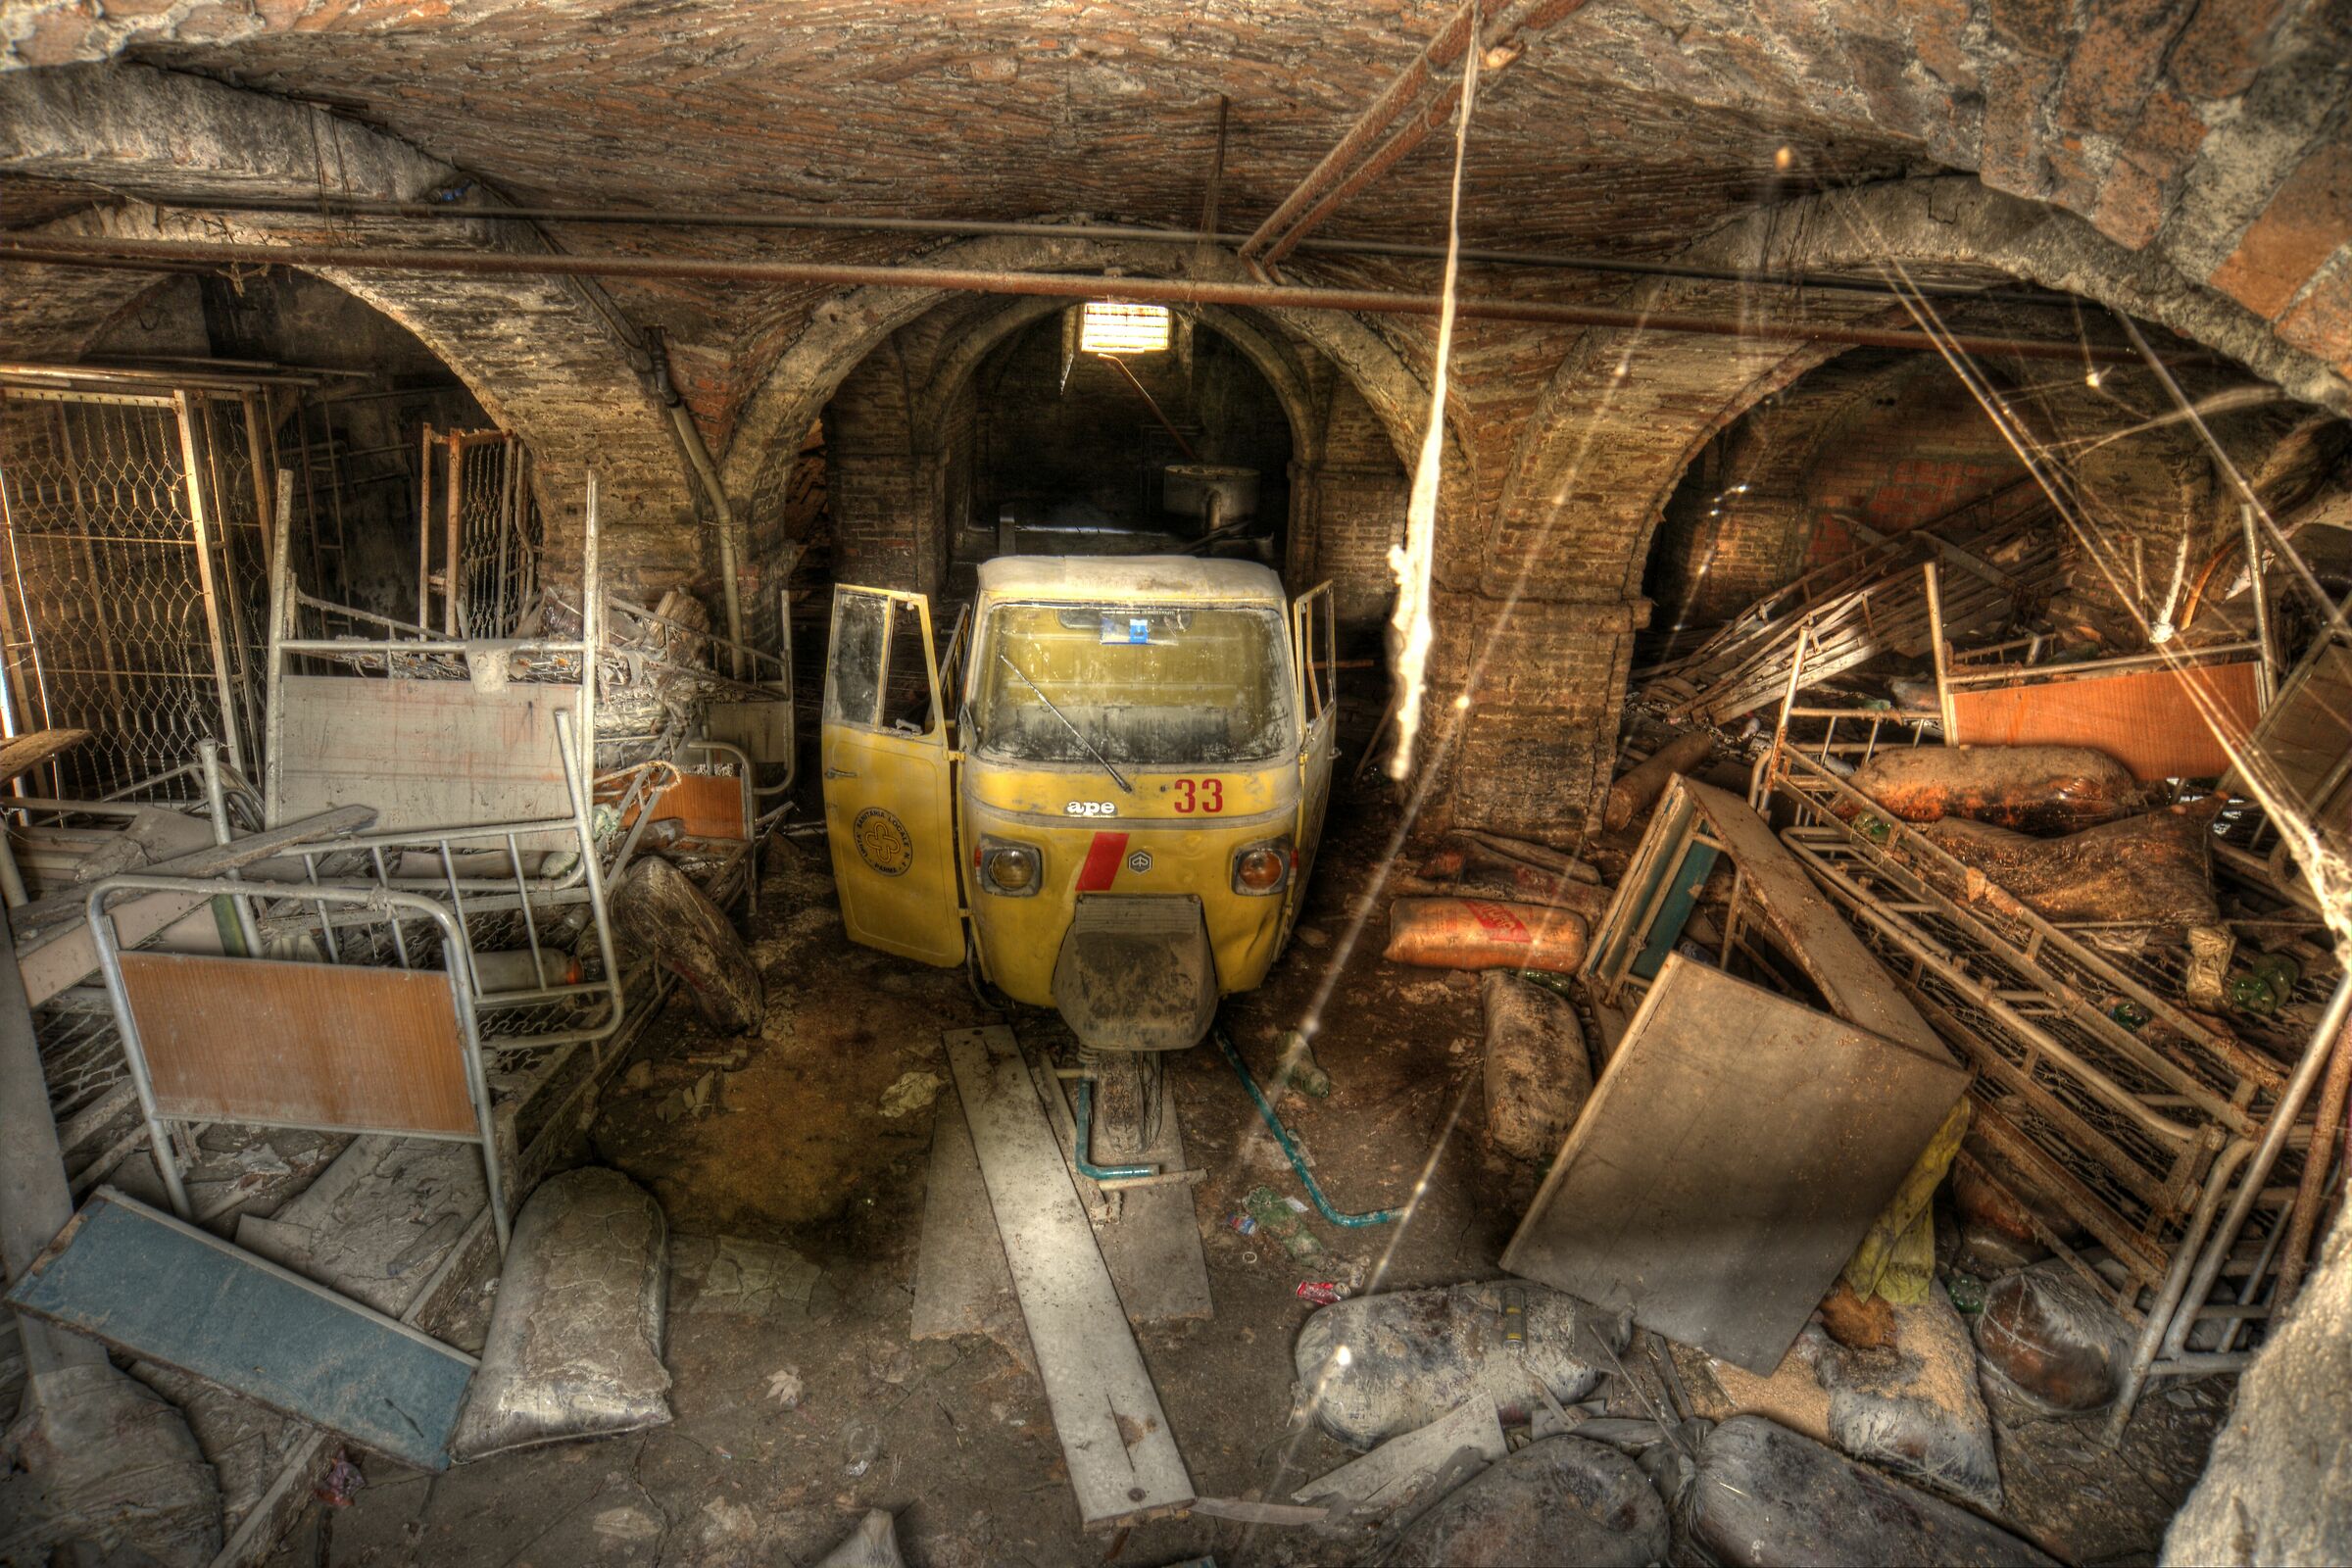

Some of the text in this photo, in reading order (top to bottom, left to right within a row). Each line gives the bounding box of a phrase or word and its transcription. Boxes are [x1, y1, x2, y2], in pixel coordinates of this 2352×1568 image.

[1066, 801, 1115, 816] ape
[1174, 778, 1223, 813] 33
[888, 815, 910, 848] LOCALE
